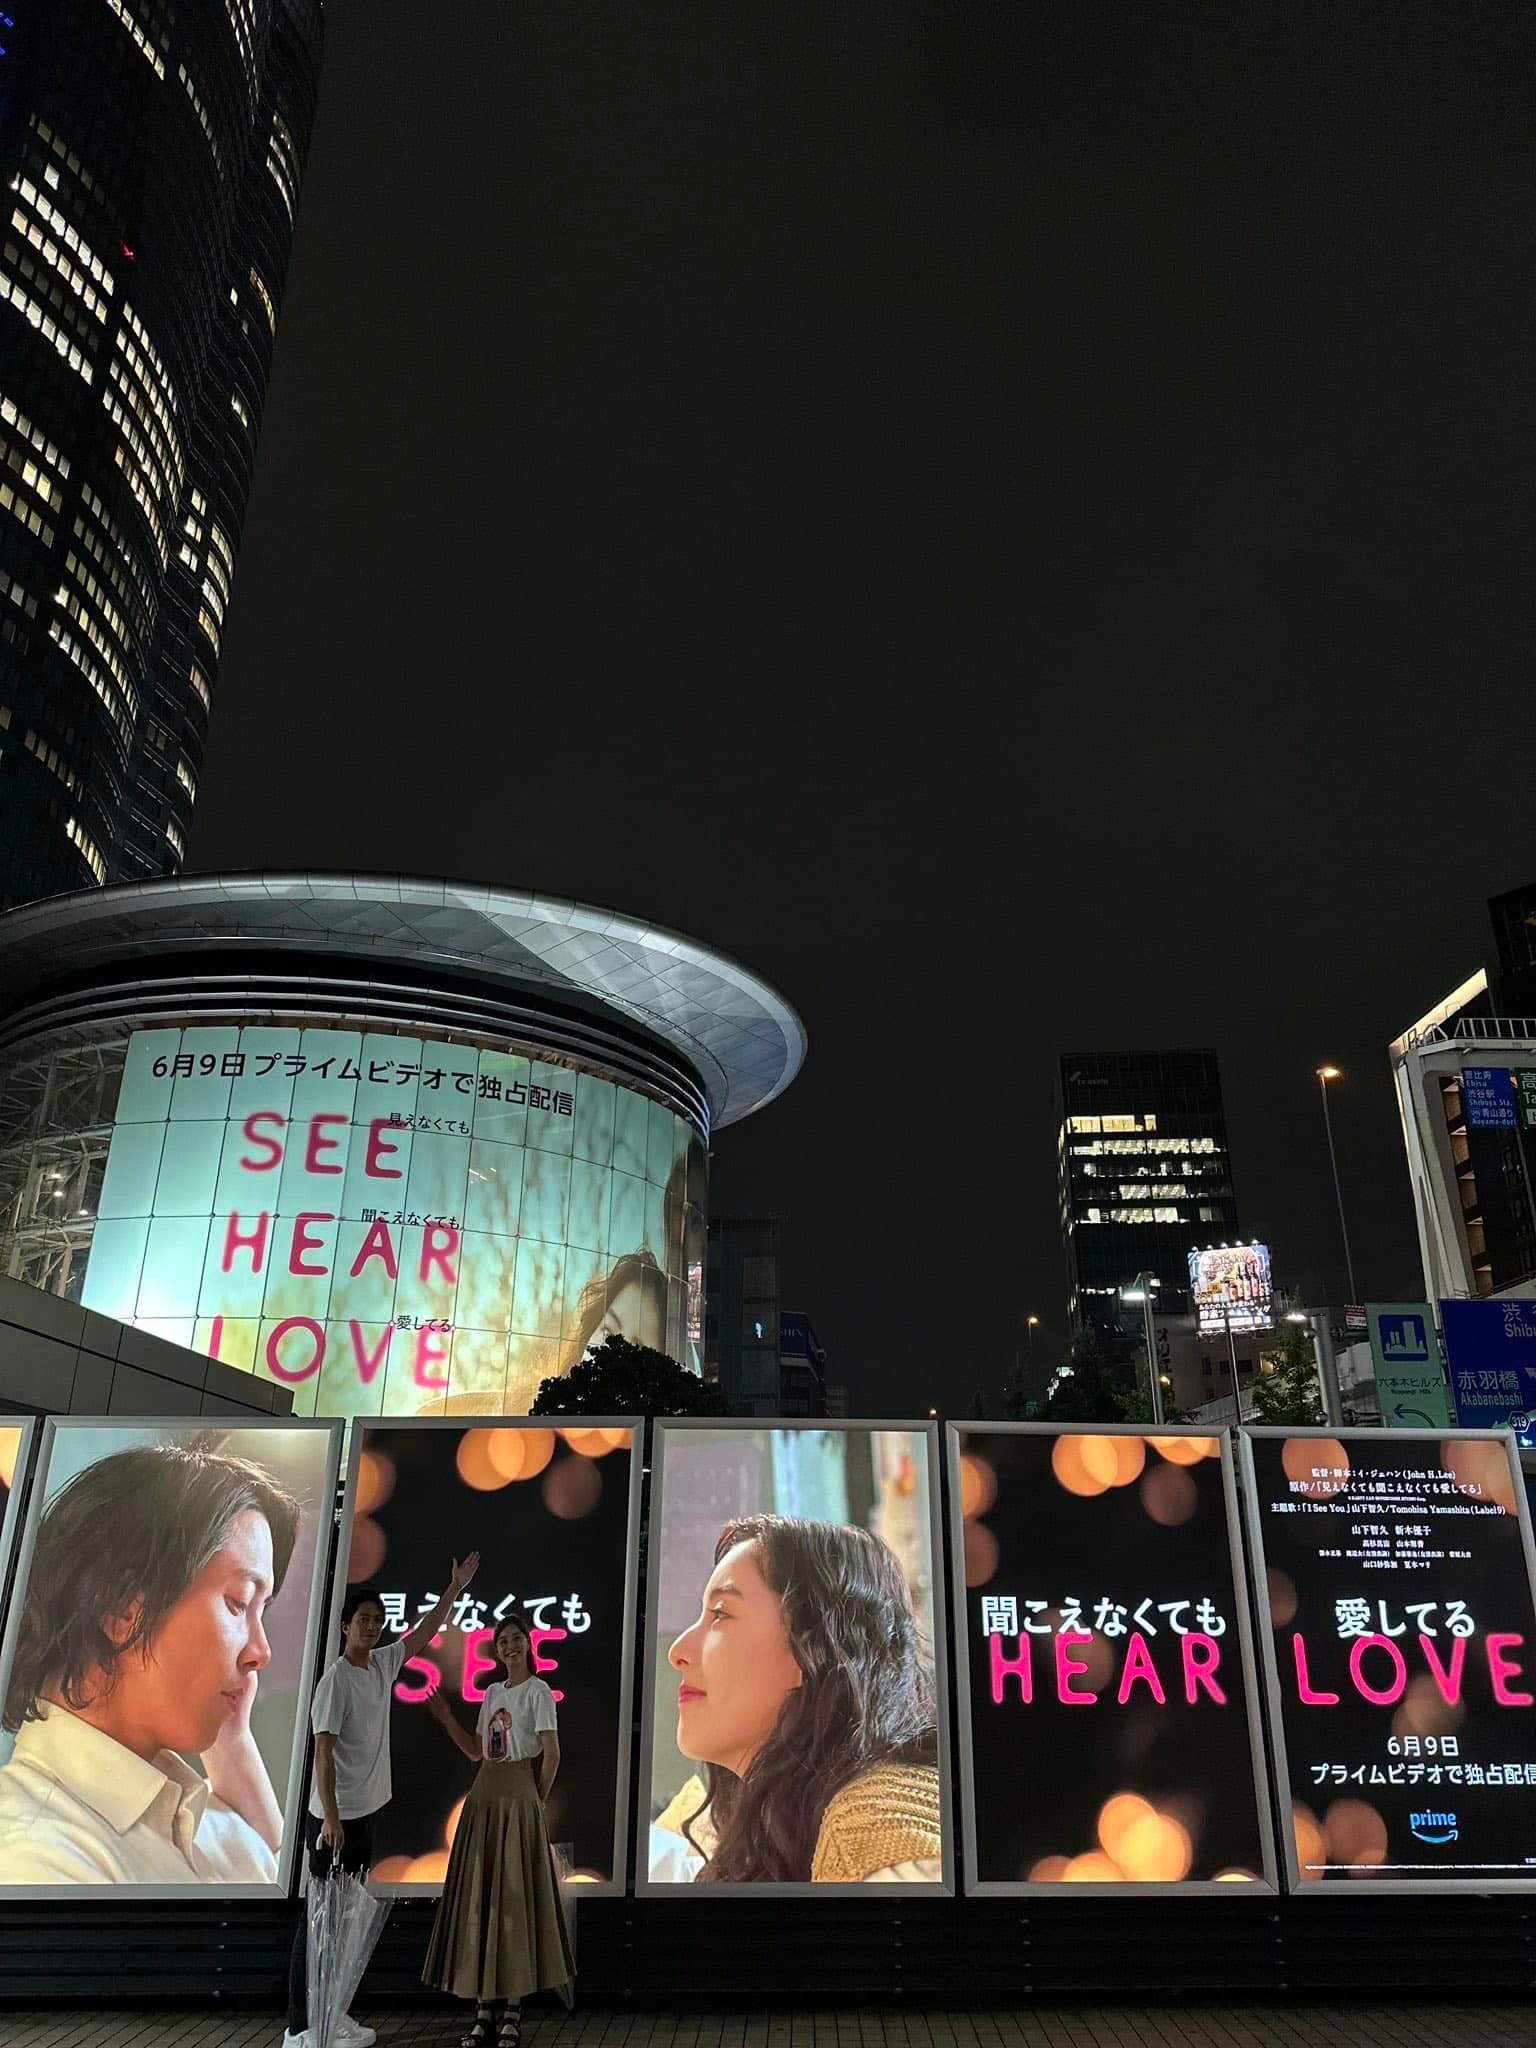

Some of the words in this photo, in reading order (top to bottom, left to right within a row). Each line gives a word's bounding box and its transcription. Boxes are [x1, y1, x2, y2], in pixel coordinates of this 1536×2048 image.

[389, 1112, 470, 1135] 見えなくても
[240, 1112, 405, 1179] SEE
[361, 1208, 460, 1230] 聞こえなくても
[222, 1211, 460, 1284] HEAR
[397, 1315, 451, 1333] 愛してる
[1458, 1371, 1519, 1391] 赤羽橋
[1460, 1392, 1523, 1406] Akabanebashi
[1511, 1416, 1527, 1428] 319
[1351, 1524, 1389, 1536] 山下智久
[981, 1595, 1227, 1637] 聞こえなくても
[1335, 1597, 1477, 1638] 愛してる
[989, 1631, 1227, 1705] HEAR
[1292, 1632, 1535, 1705] LOVE
[1387, 1735, 1460, 1757] 6月9日
[1409, 1809, 1457, 1830] prime
